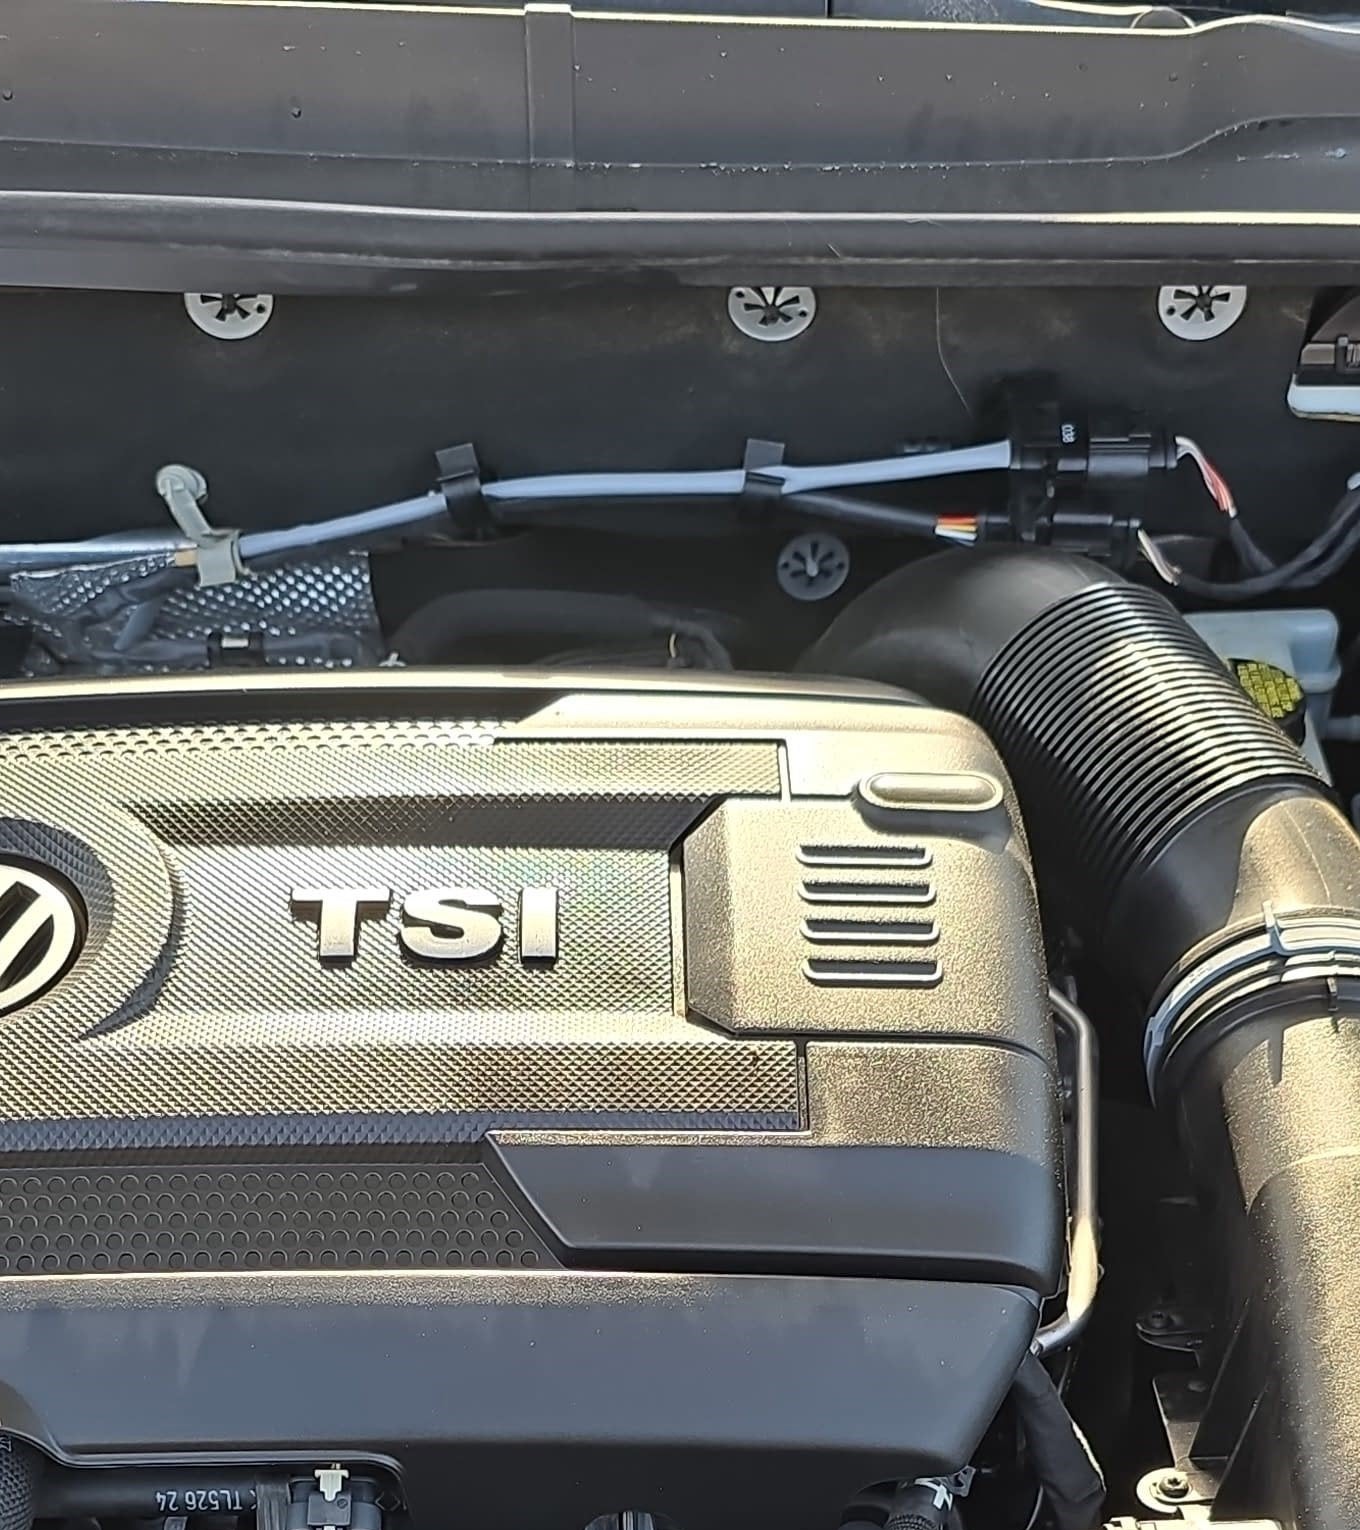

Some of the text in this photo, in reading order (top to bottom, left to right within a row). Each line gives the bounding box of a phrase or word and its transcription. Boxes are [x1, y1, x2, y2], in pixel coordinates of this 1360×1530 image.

[290, 884, 562, 969] TSI
[155, 1489, 242, 1510] TL526 24
